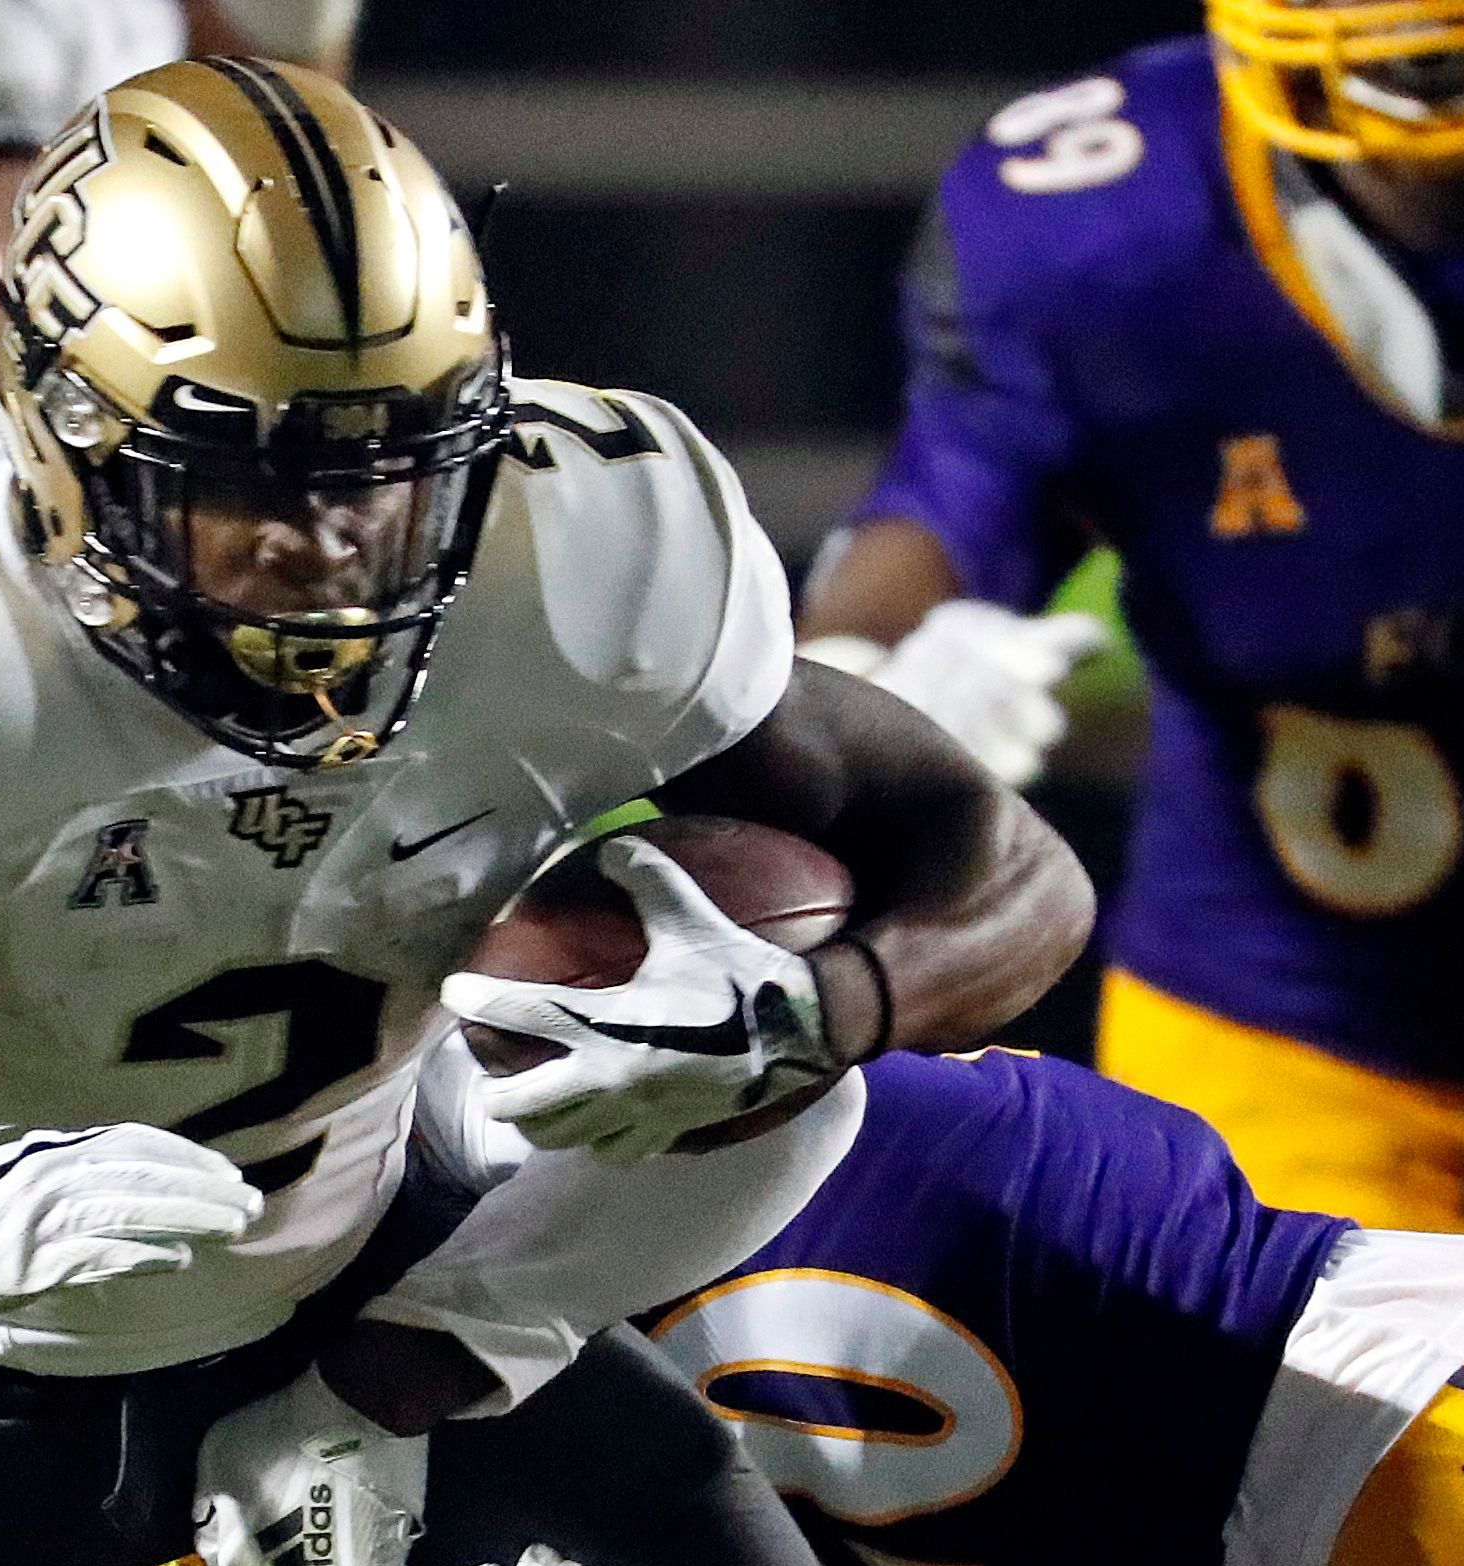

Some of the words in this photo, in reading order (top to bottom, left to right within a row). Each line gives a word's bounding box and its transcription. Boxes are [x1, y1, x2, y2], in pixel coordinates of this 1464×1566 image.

[505, 396, 666, 474] 2
[226, 784, 332, 869] UCF
[120, 958, 389, 1198] 2
